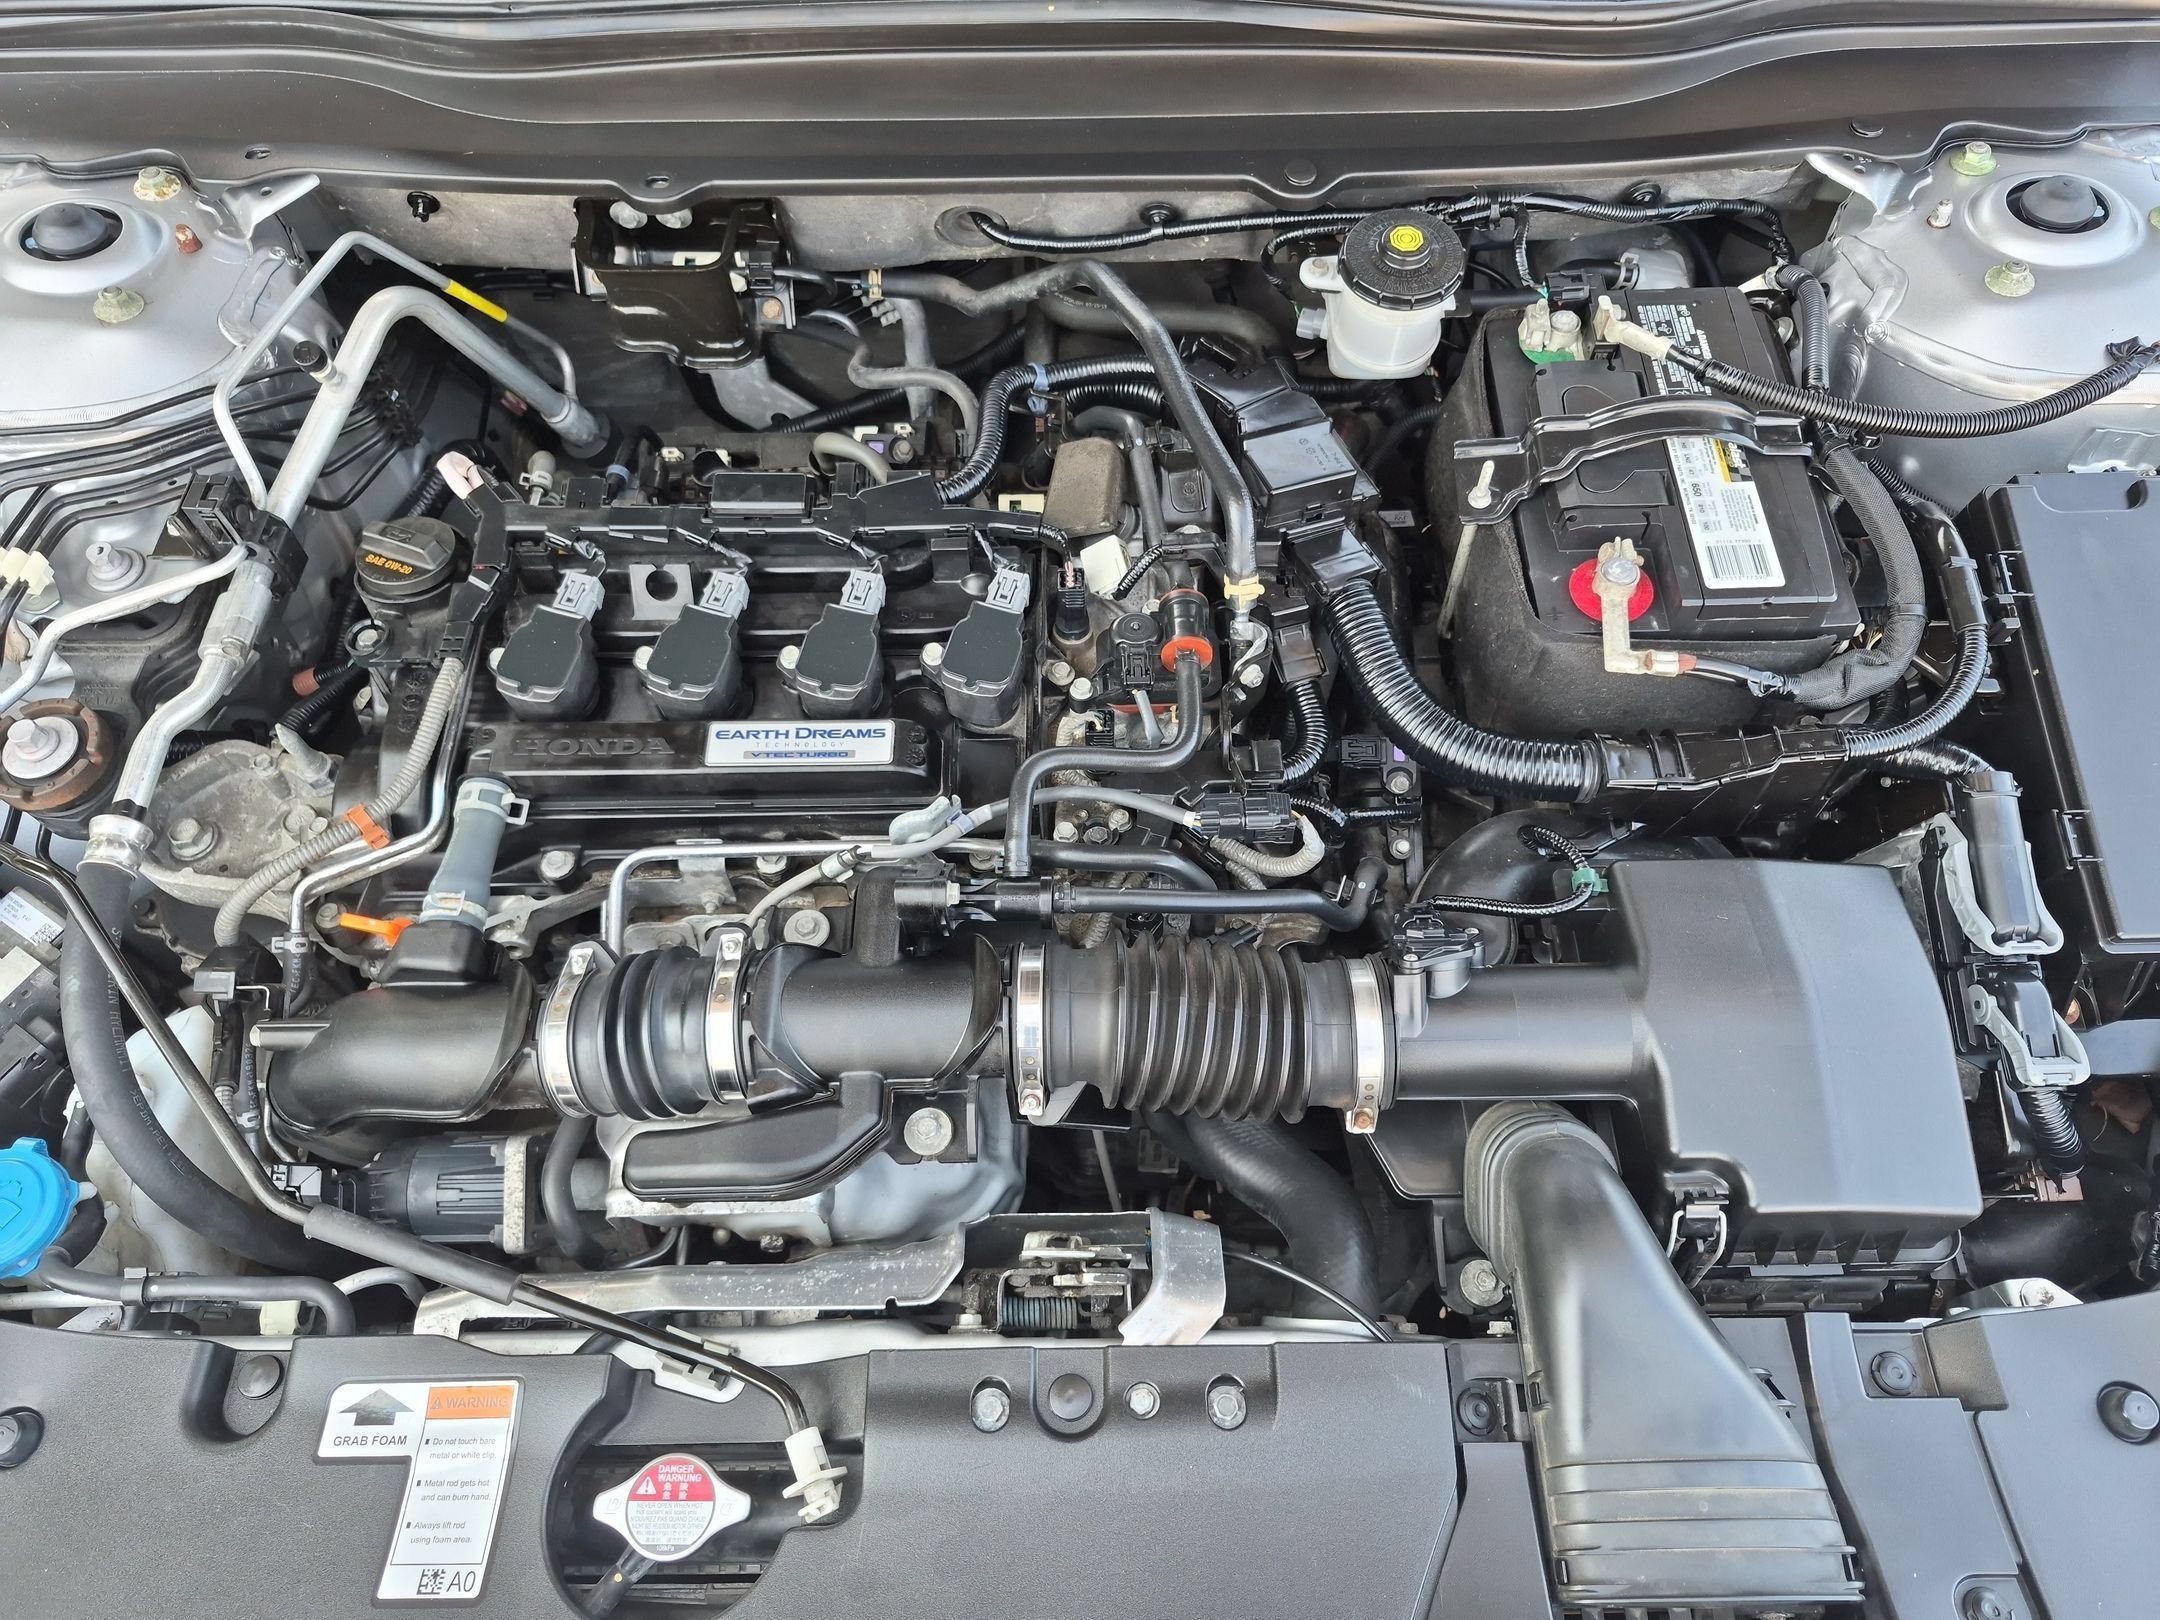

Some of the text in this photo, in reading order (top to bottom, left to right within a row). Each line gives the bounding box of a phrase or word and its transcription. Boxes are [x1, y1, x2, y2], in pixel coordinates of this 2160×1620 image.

[1728, 442, 1746, 468] alast
[1692, 483, 1702, 496] 650
[366, 554, 413, 575] SAE 0W-20
[715, 728, 886, 740] EARTH DREAMS
[512, 738, 676, 756] HONDA
[446, 1397, 508, 1408] WARNING
[333, 1435, 408, 1446] GRAB FOAM
[458, 1437, 476, 1445] touch
[478, 1437, 496, 1445] bare
[658, 1465, 694, 1473] DANGER
[658, 1473, 702, 1482] WARNUNG
[460, 1480, 476, 1488] gets
[414, 1522, 440, 1530] Always
[410, 1536, 431, 1545] using
[446, 1570, 476, 1592] A0
